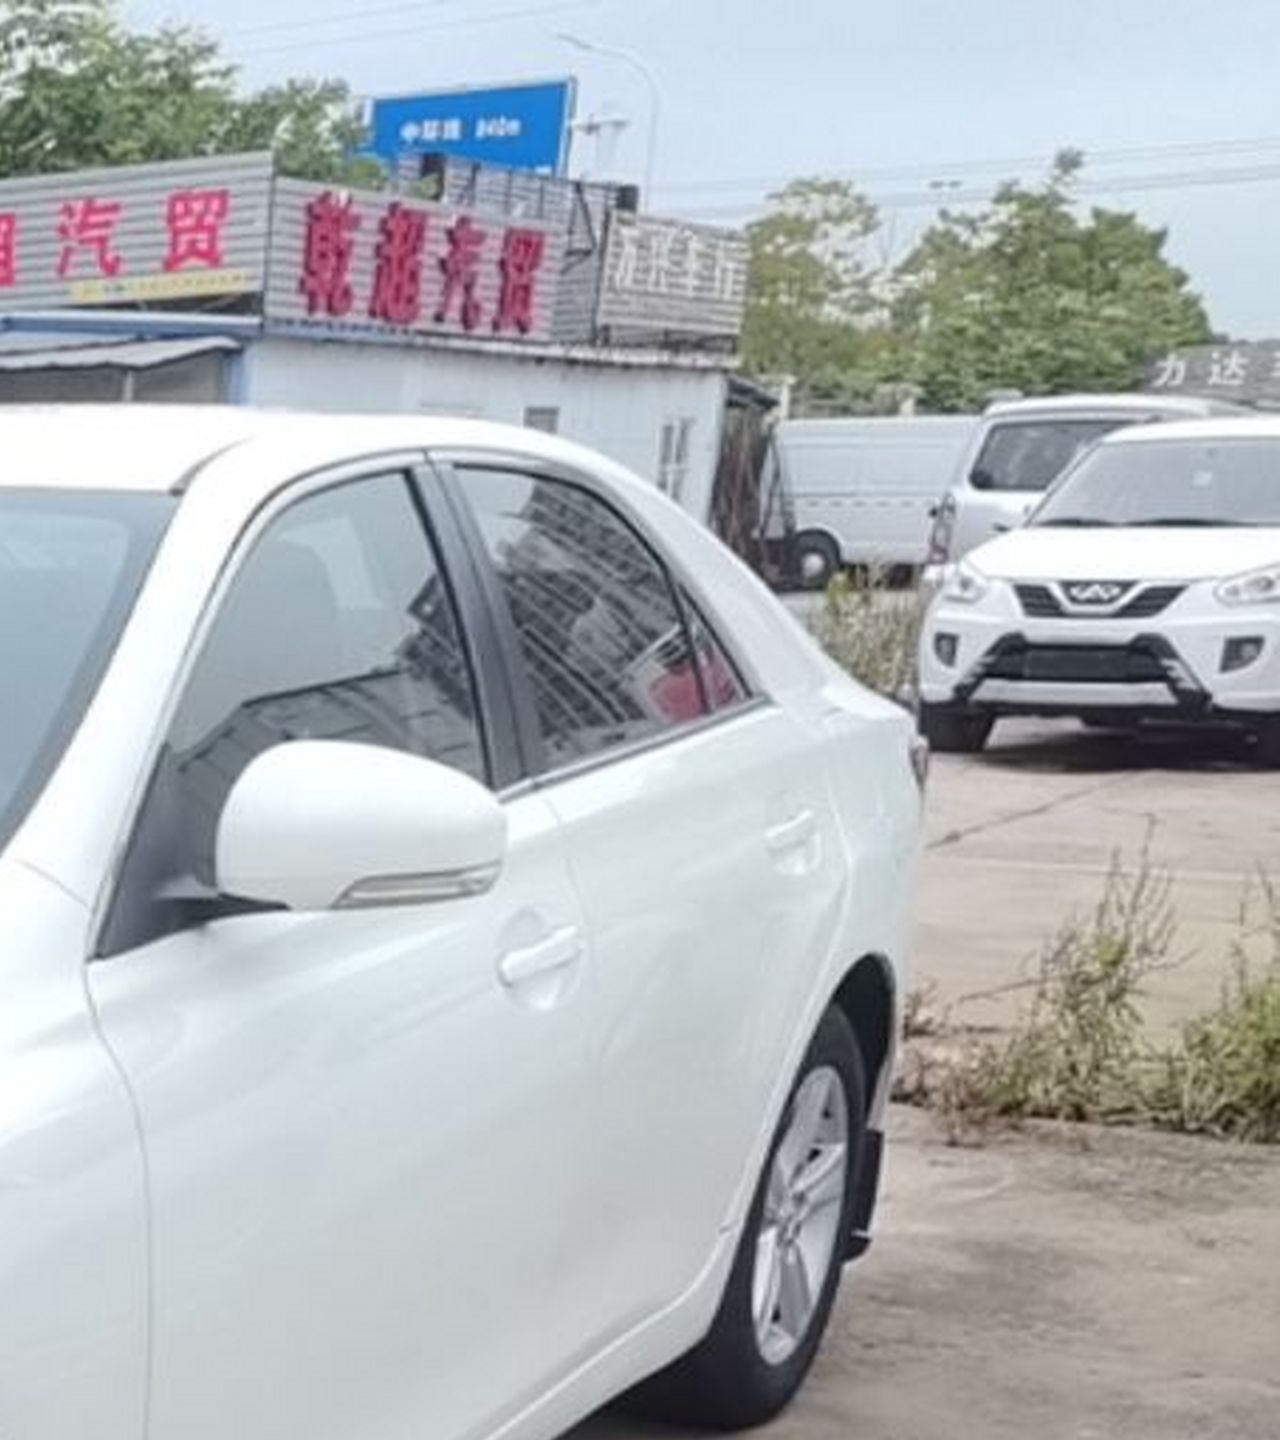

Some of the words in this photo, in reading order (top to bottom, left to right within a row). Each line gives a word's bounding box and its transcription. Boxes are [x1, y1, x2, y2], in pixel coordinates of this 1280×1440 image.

[298, 189, 546, 333] 乾超汽贸
[1151, 350, 1280, 388] 力达
